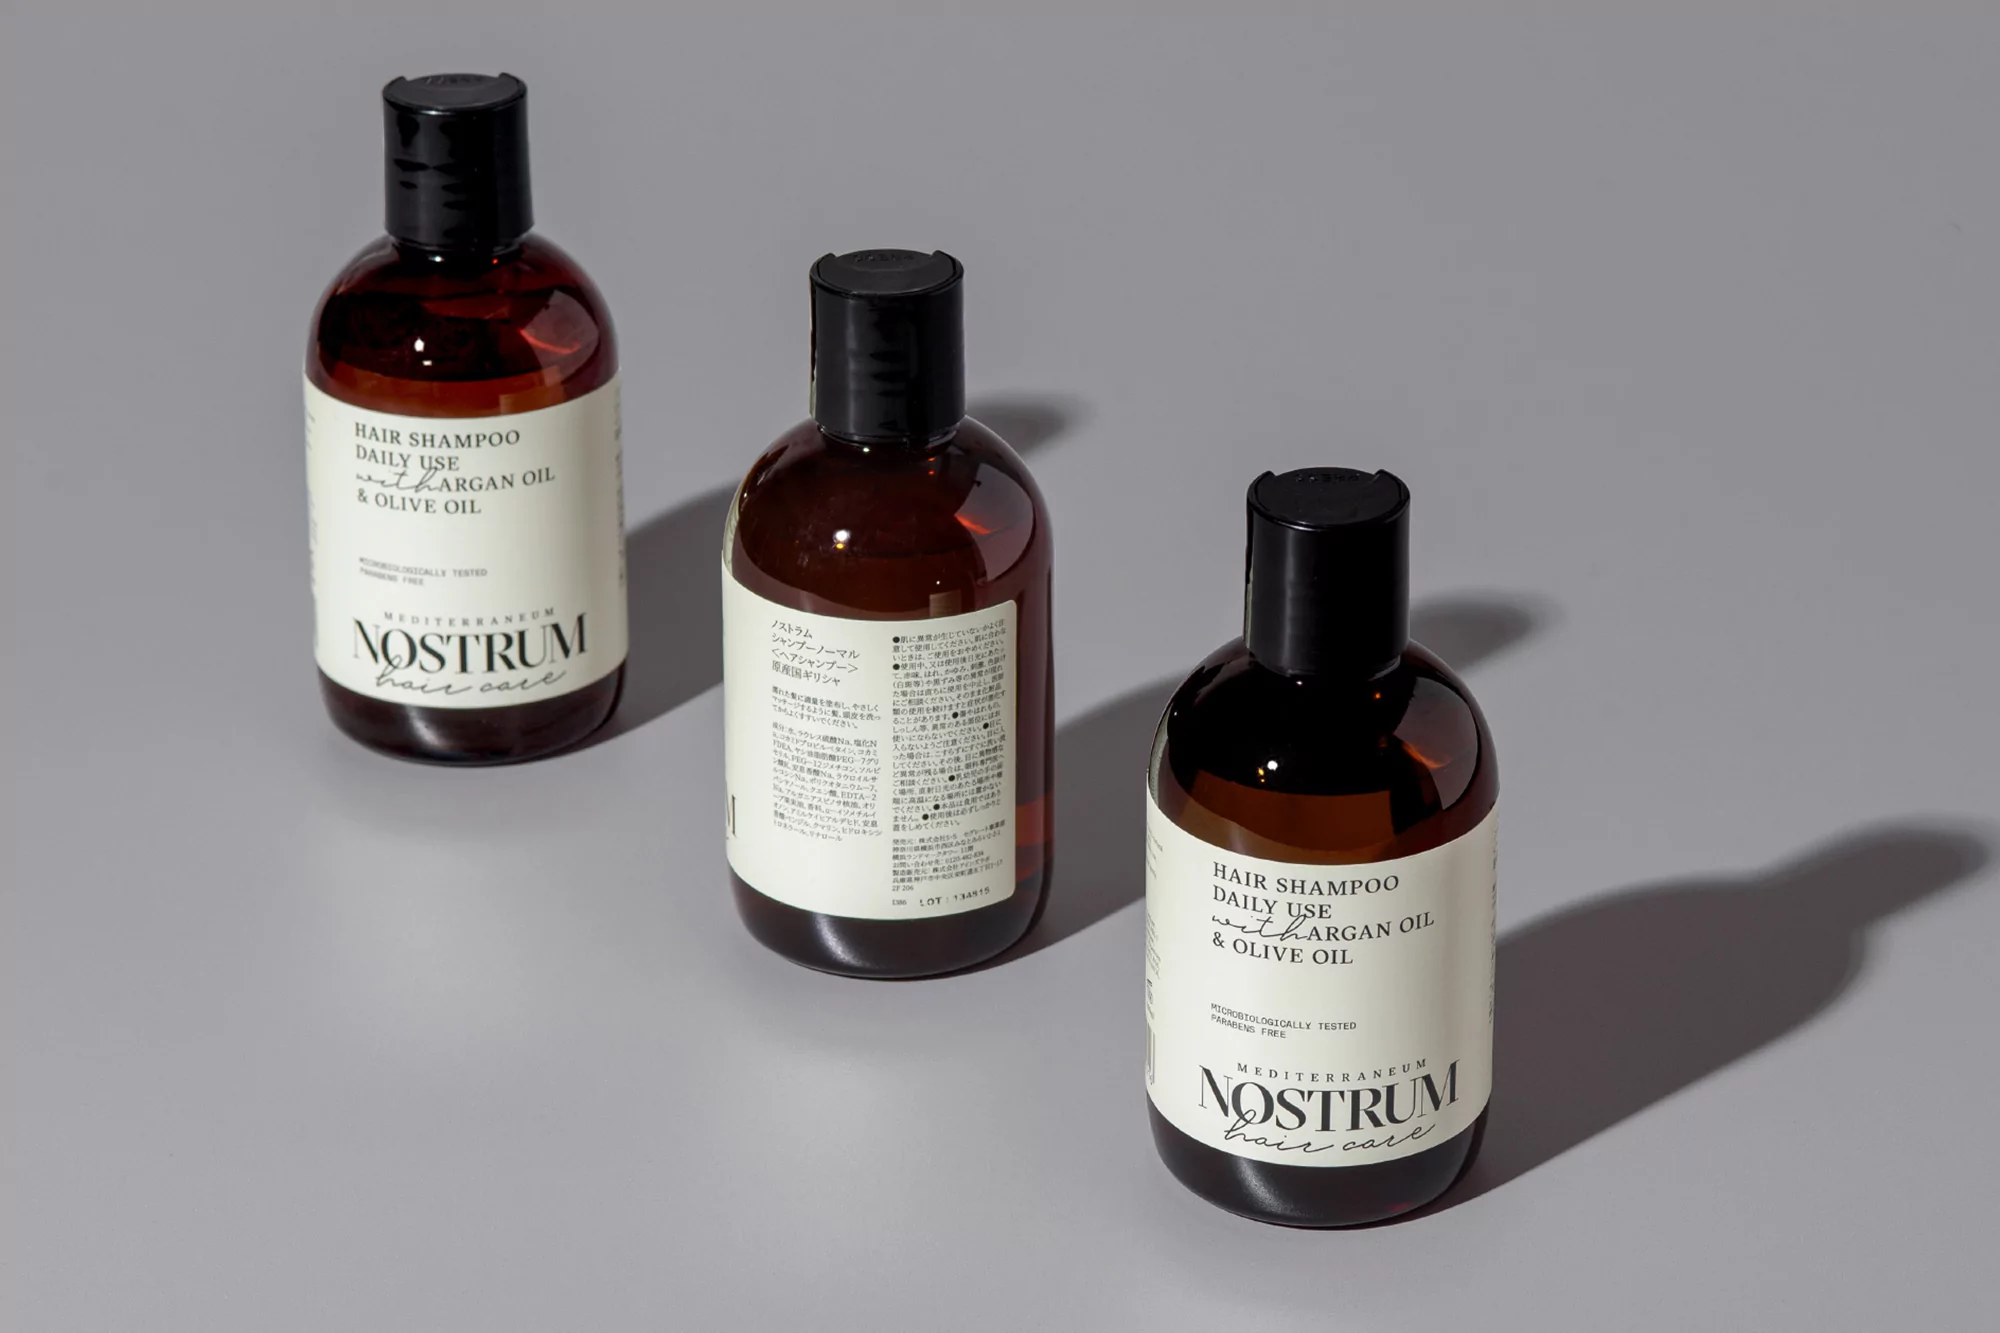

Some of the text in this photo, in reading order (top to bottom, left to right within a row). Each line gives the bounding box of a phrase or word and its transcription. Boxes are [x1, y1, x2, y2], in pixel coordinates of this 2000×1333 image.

[355, 422, 520, 448] HAIR SHAMPOO
[356, 444, 460, 471] DAILY USE
[356, 467, 555, 493] with ARGAN OIL
[357, 489, 481, 514] & OLIVE OIL
[359, 557, 446, 577] MICROBIOLOGICALLY
[360, 568, 425, 586] PARABENS FREE
[384, 608, 555, 626] MEDITERRANEUM
[772, 620, 813, 639] ノストラム
[352, 612, 587, 674] NOSTRUM
[376, 655, 566, 695] hair care
[772, 660, 841, 686] 原産国ギリシャ
[1213, 861, 1399, 895] HAIR SHAMPOO
[919, 897, 942, 907] LOT
[1213, 886, 1332, 919] DAILY USE
[1212, 912, 1435, 941] with ARGAN OIL
[1213, 932, 1353, 964] & OLIVE OIL
[1211, 1003, 1357, 1031] MICROBIOLOGICALLY TESTED
[1211, 1015, 1286, 1038] PARABENS FREE
[1237, 1059, 1427, 1082] MEDITERRANEUM
[1198, 1059, 1460, 1132] NOSTRUM
[1224, 1109, 1436, 1153] hair care
